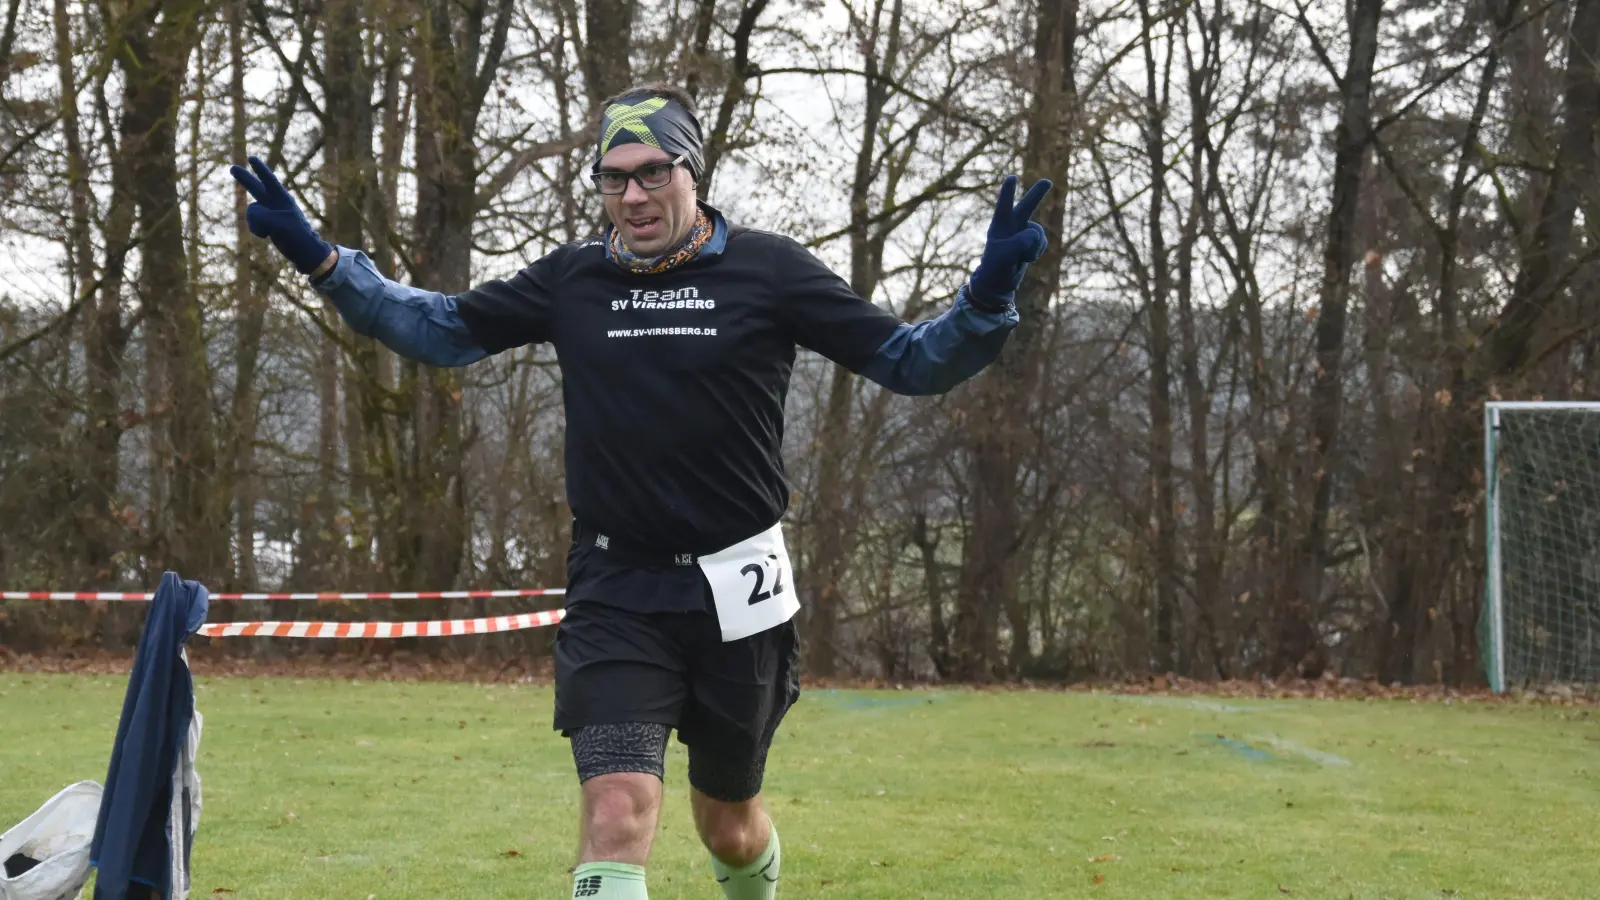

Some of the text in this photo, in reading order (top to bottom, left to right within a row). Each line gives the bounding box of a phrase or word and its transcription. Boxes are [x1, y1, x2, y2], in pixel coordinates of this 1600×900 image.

[630, 287, 698, 301] Team
[611, 300, 715, 311] SV VIRNSBERG
[607, 328, 717, 338] WWW.SV-VIRNSBERG.DE
